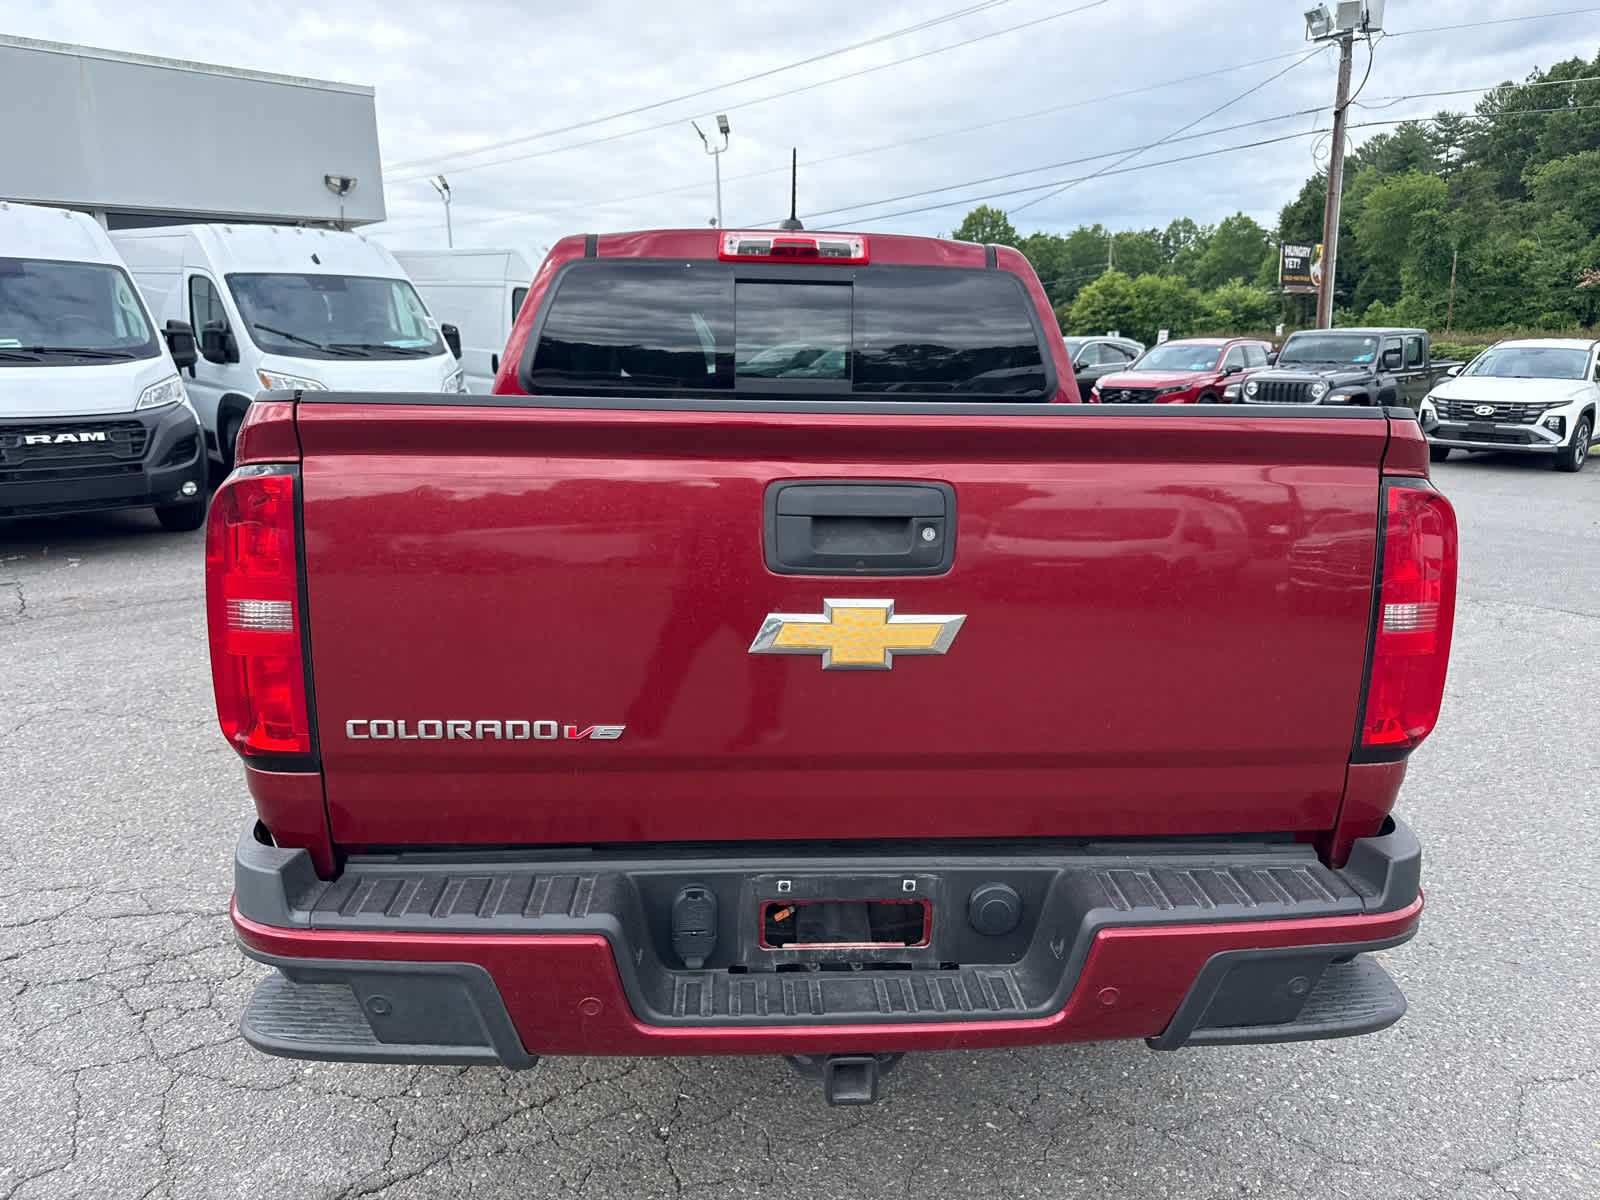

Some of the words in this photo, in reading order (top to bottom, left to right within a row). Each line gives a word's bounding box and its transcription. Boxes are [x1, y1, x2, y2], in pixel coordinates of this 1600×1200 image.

[1285, 245, 1311, 257] HUNGRY
[25, 432, 106, 444] RAM
[345, 720, 559, 740] COLORADO
[563, 725, 626, 740] V6
